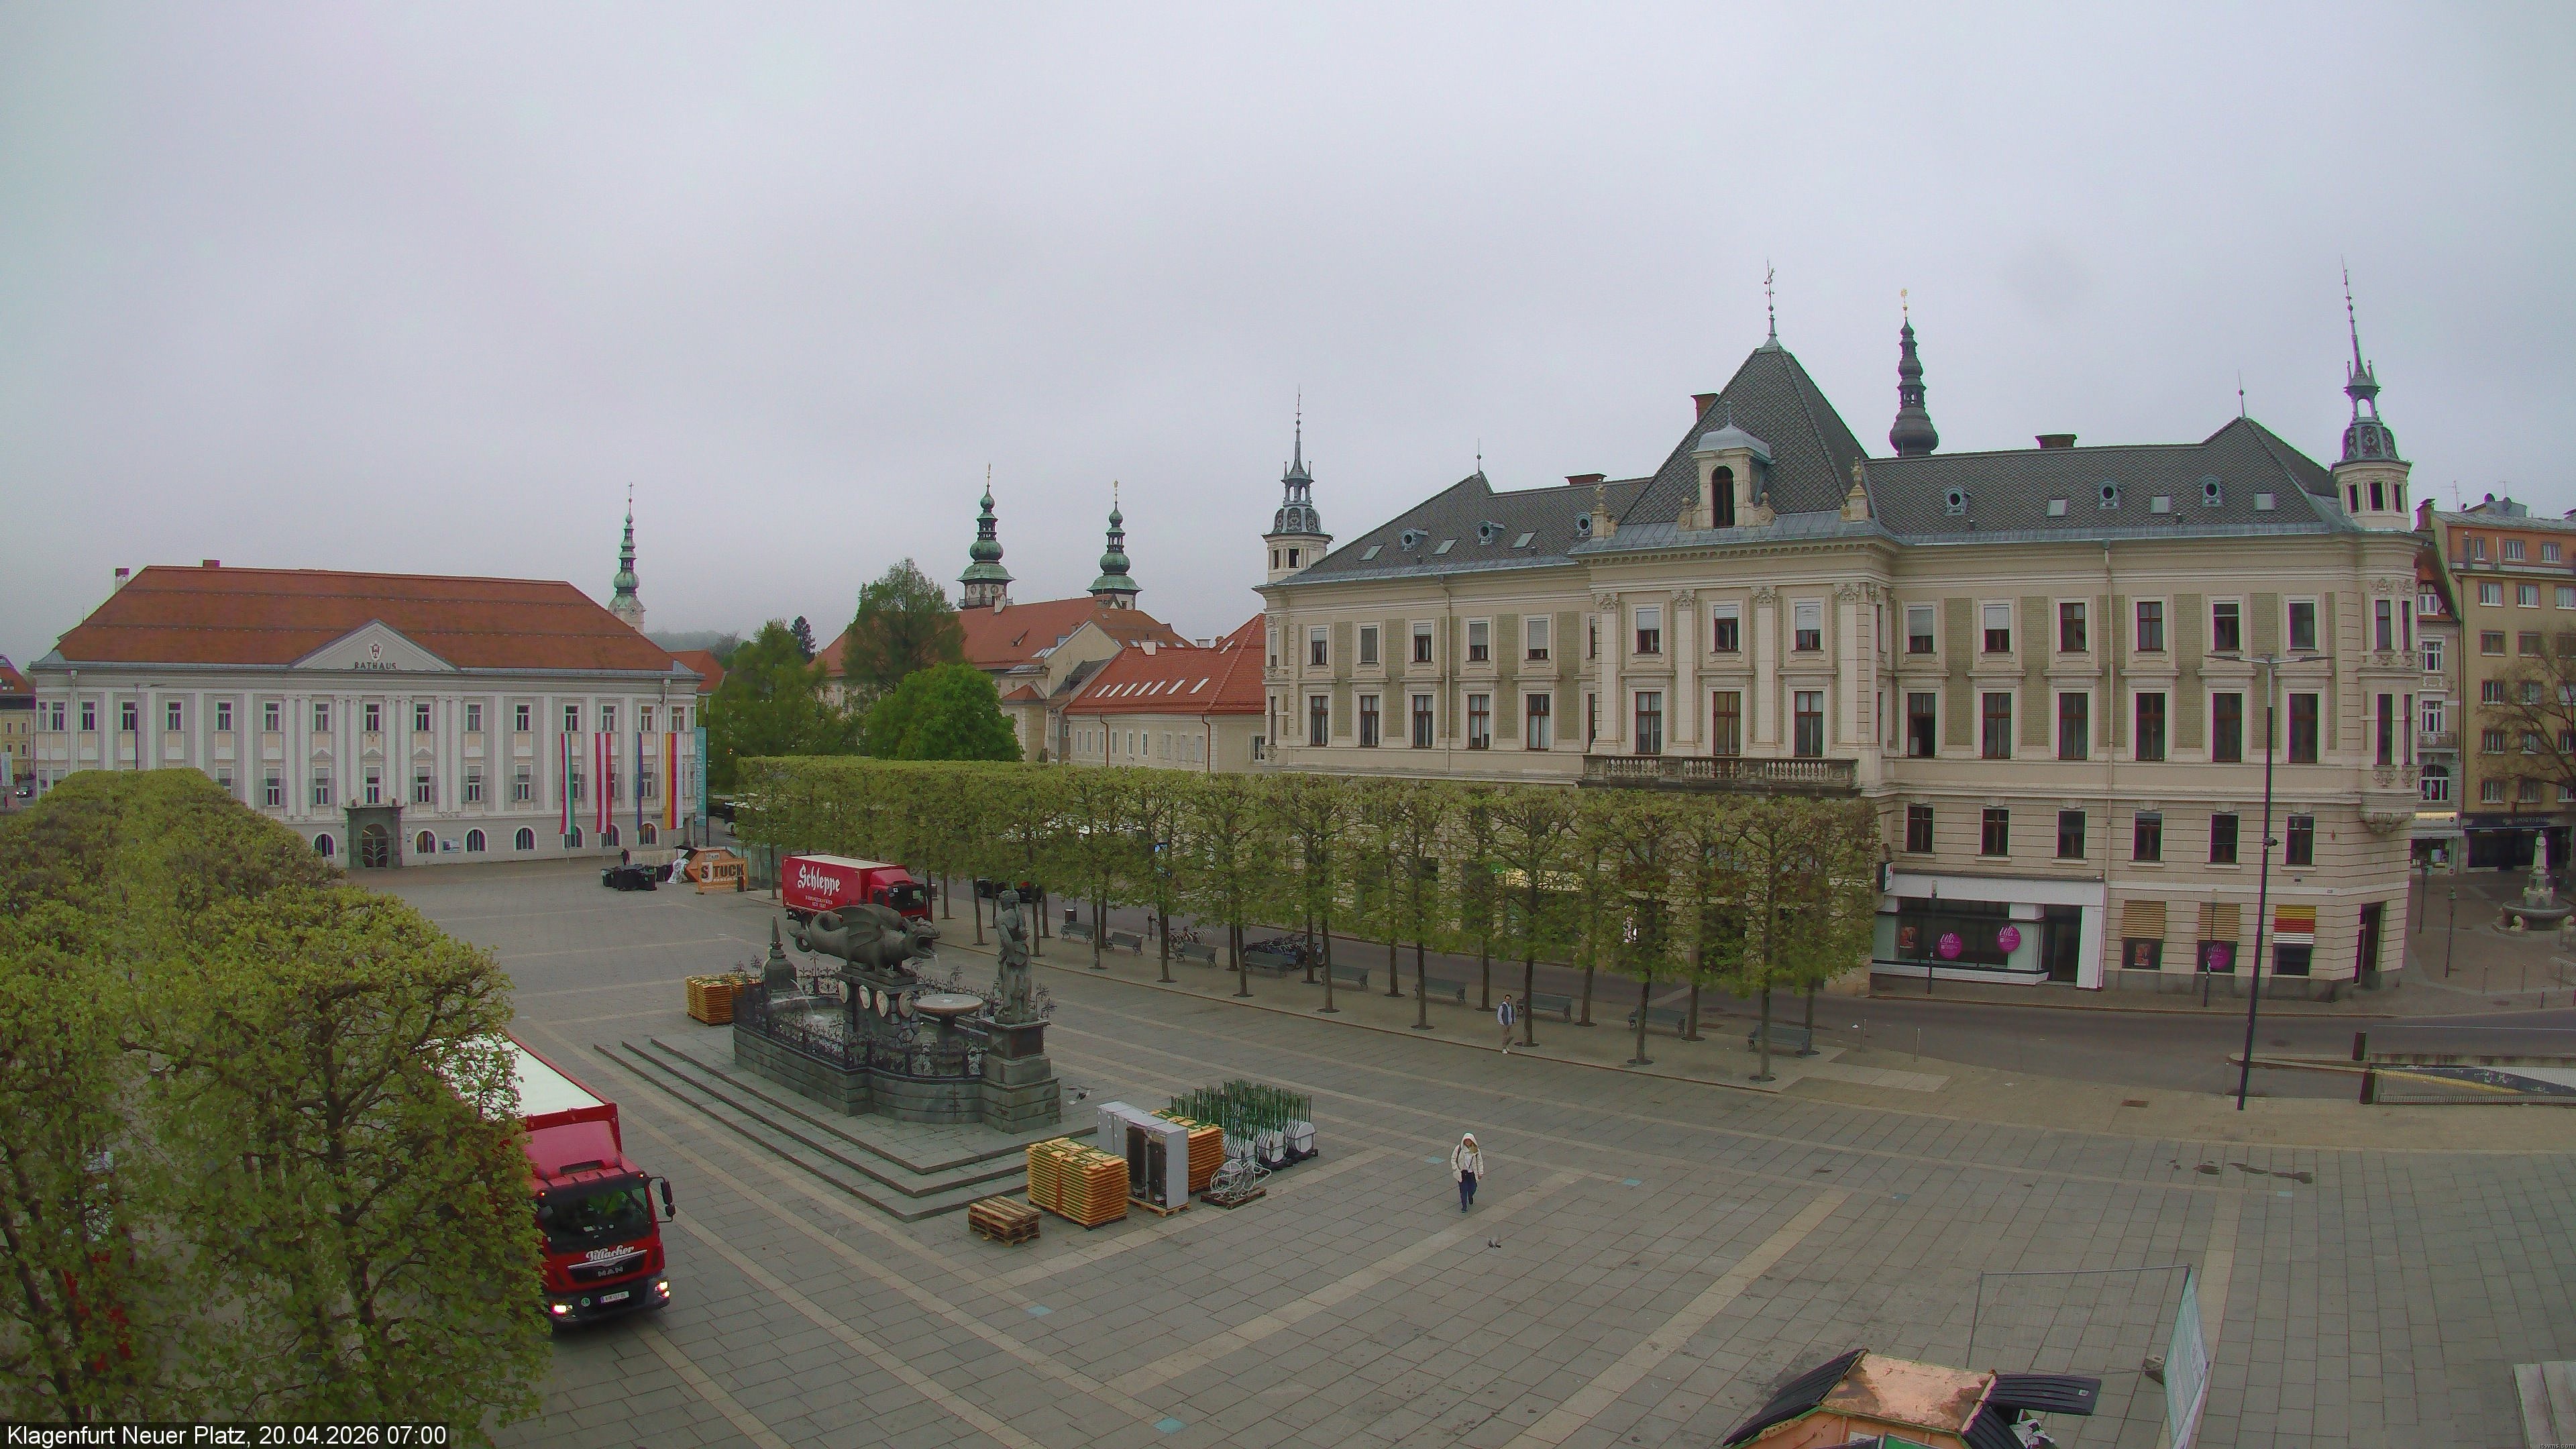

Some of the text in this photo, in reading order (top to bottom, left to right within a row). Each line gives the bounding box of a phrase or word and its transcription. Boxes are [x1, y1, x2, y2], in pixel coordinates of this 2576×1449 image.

[354, 661, 397, 669] RATHAUS
[797, 863, 841, 897] Schleppe
[586, 1244, 635, 1261] Villacher
[597, 1266, 624, 1277] MAN
